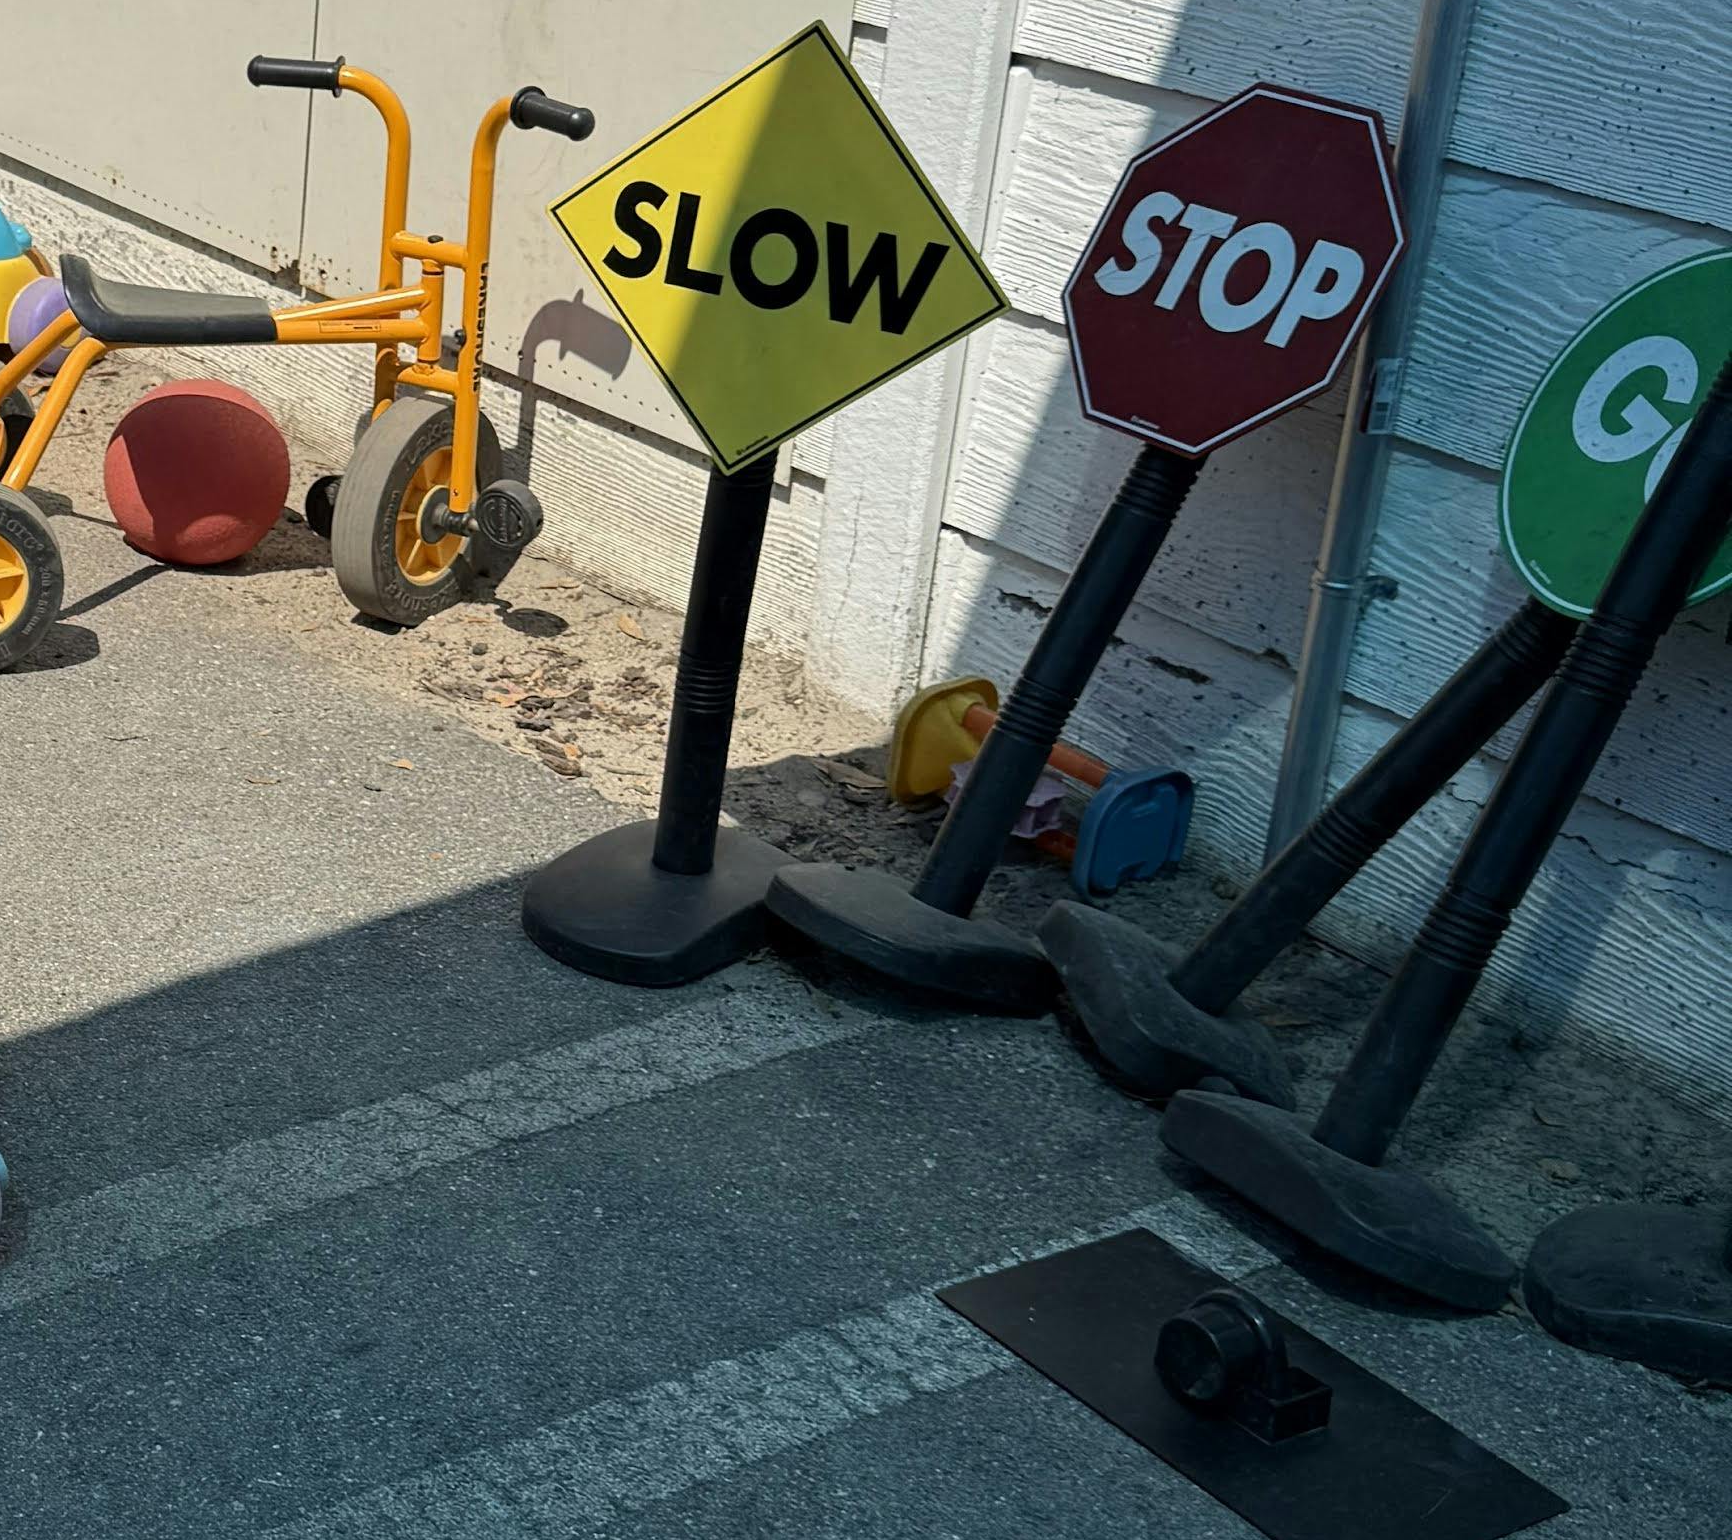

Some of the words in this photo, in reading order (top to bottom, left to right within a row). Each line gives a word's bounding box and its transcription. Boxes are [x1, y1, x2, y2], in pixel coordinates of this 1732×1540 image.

[602, 180, 950, 335] SLOW
[1094, 191, 1364, 348] STOP
[1572, 335, 1698, 504] G
